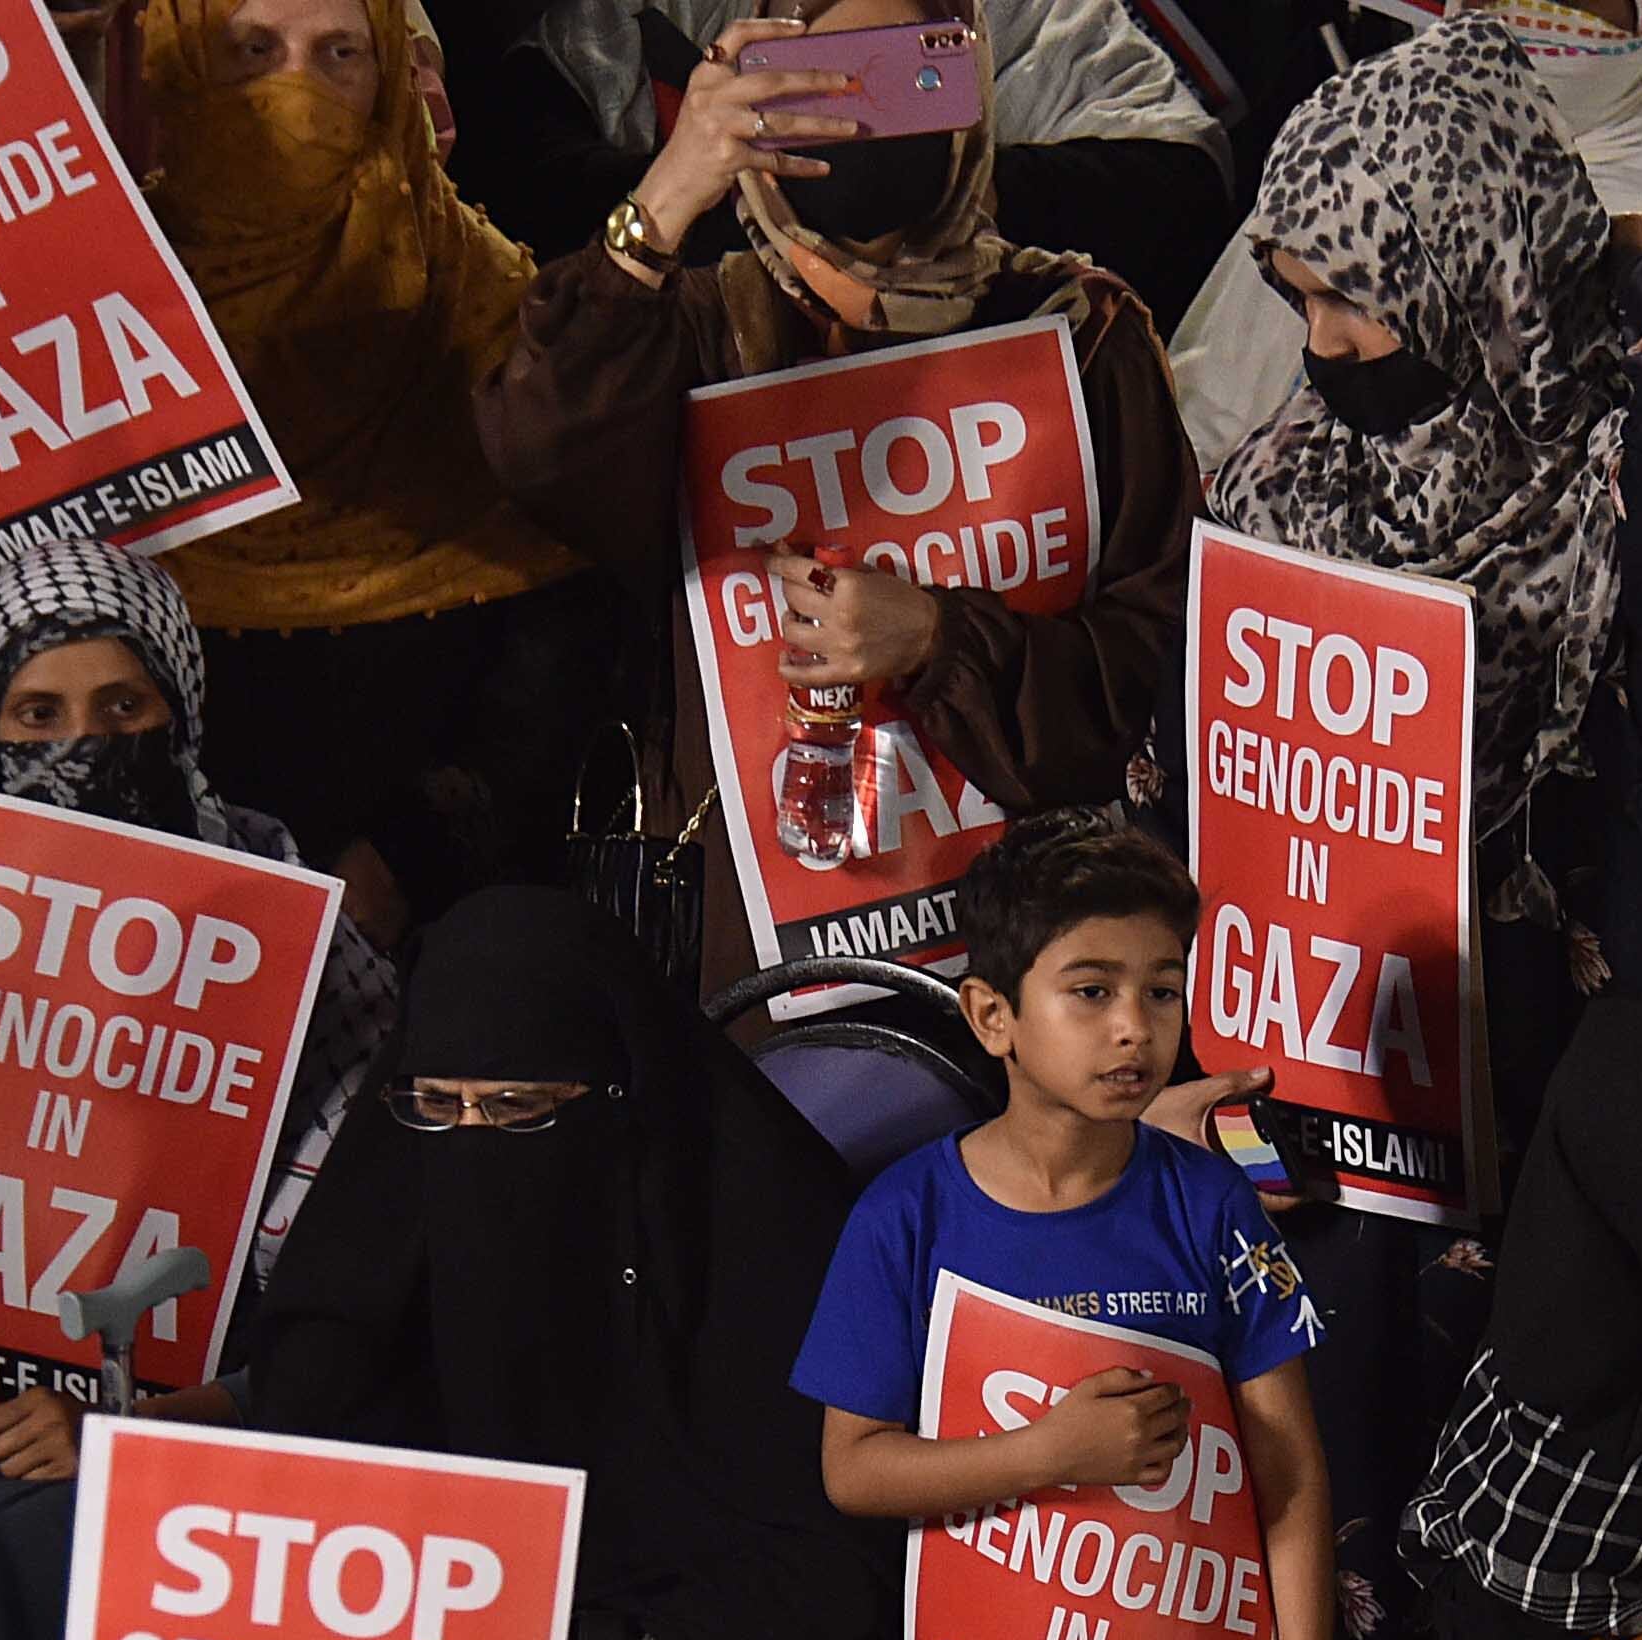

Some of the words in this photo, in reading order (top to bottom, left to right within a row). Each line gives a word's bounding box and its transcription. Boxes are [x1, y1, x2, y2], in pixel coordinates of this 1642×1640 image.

[720, 400, 1027, 548] STOP
[810, 685, 855, 710] NEXT
[1223, 606, 1429, 747] STOP
[1208, 718, 1444, 855] GENOCIDE
[1287, 836, 1329, 905] IN
[1210, 903, 1433, 1088] GAZA
[27, 1089, 92, 1158] IN
[1107, 1292, 1170, 1317] STREET
[1175, 1292, 1208, 1316] ART
